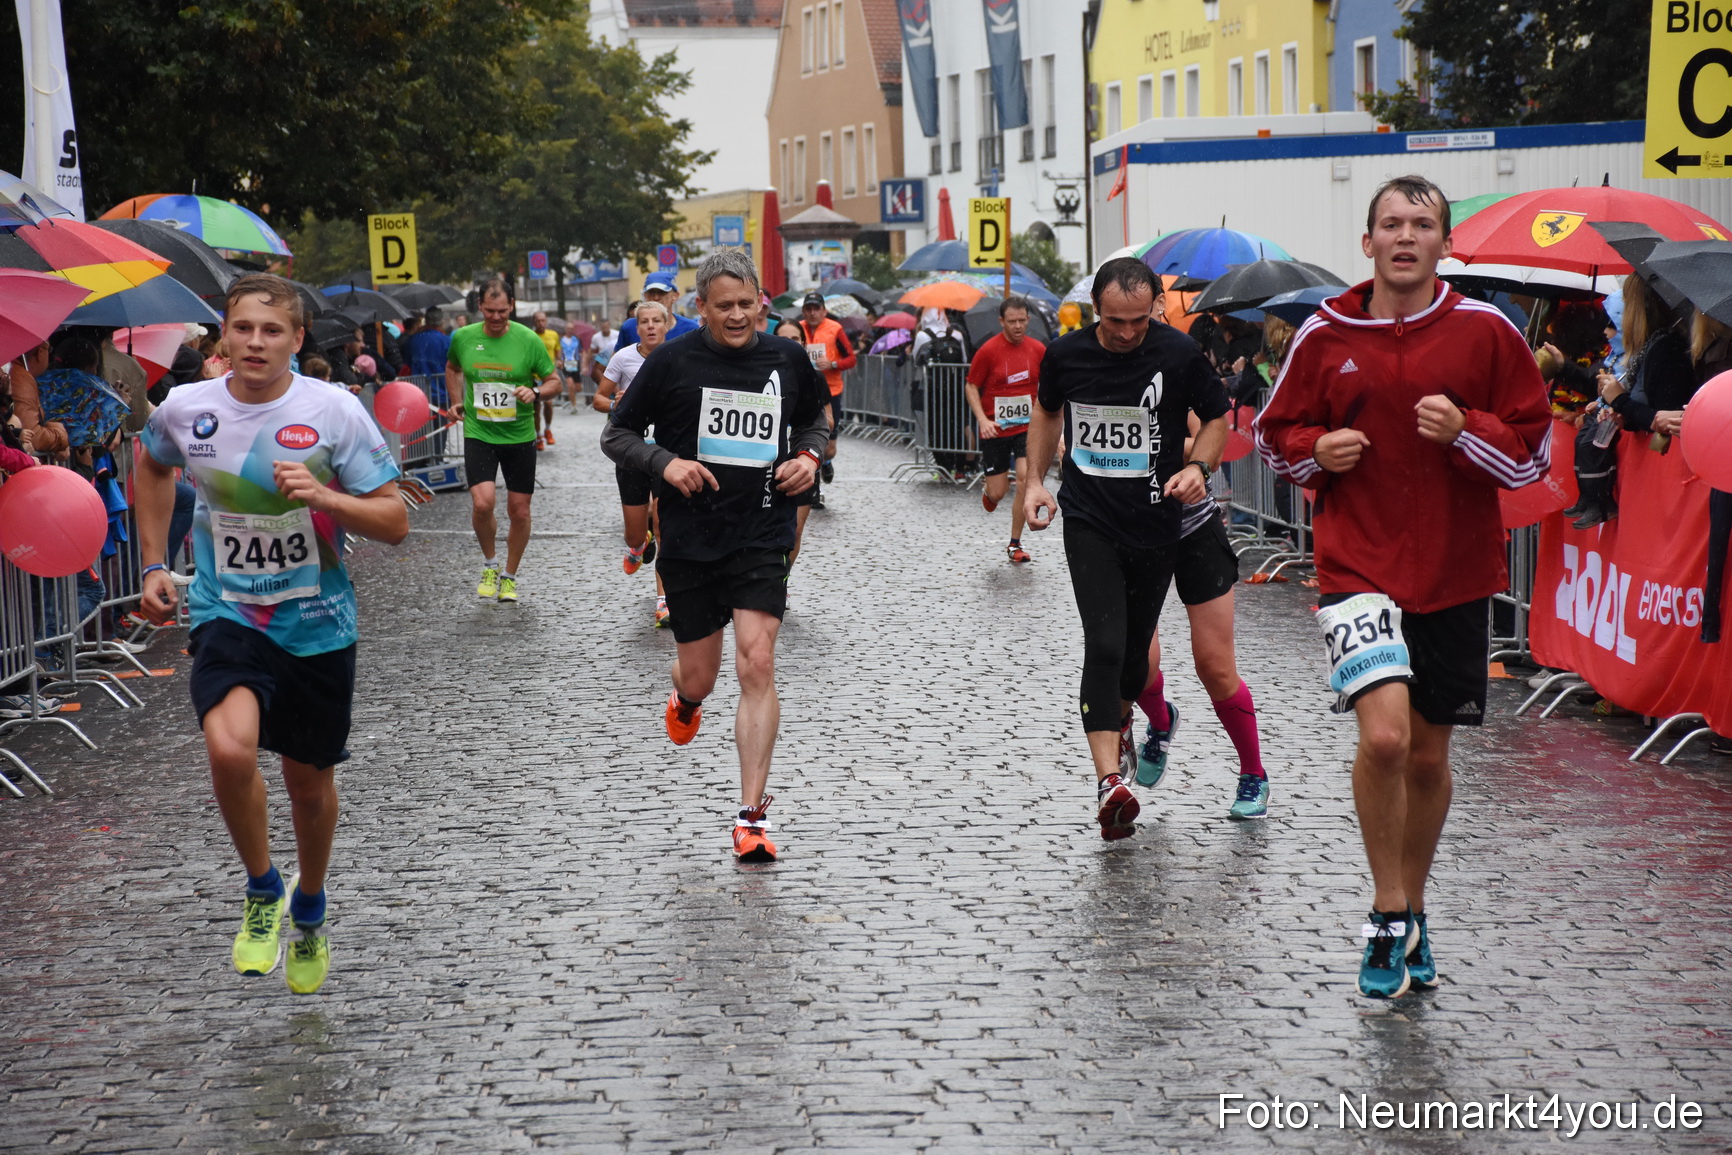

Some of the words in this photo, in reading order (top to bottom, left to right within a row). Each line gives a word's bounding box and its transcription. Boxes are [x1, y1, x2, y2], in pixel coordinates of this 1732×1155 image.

[1145, 31, 1173, 63] HOTEL
[1678, 47, 1732, 139] C
[974, 200, 1006, 213] Block
[374, 217, 410, 230] Block
[980, 219, 1001, 252] D
[382, 236, 406, 269] D
[532, 269, 547, 277] TAXI
[1339, 365, 1358, 374] adidas
[482, 392, 508, 407] 612
[738, 394, 775, 407] BOCK
[998, 403, 1029, 418] 2649
[1102, 408, 1141, 418] BOCK
[708, 407, 774, 440] 3009
[281, 430, 315, 443] Hervis
[1078, 421, 1143, 450] 2458
[188, 443, 216, 453] PARTL
[1089, 454, 1130, 468] Andreas
[252, 512, 302, 530] BOCK
[223, 532, 308, 569] 2443
[248, 578, 289, 593] Julian
[1325, 608, 1394, 667] 2254
[1339, 650, 1397, 684] Alexander
